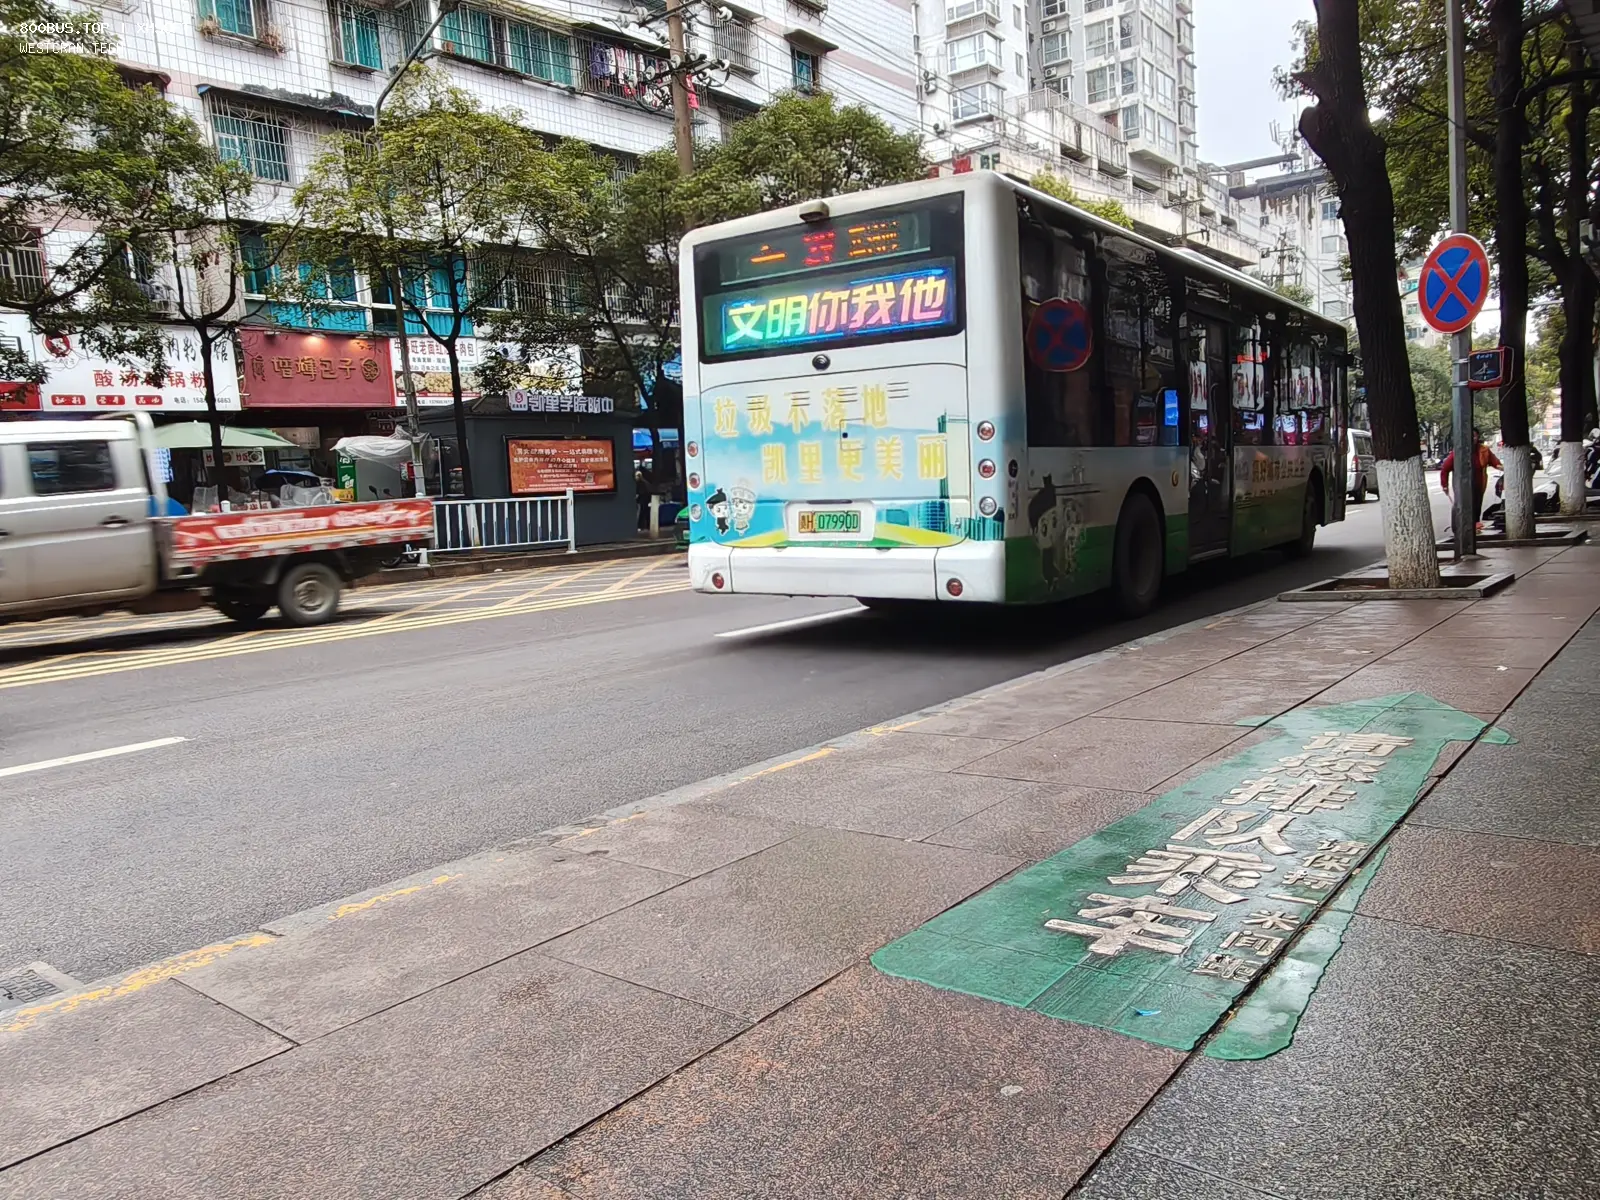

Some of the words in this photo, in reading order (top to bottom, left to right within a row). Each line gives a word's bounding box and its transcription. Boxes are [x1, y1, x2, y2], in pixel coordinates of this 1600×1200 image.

[726, 276, 947, 345] 文明你我他
[93, 369, 206, 389] 酸汤锅粉
[528, 394, 615, 414] 凯里学院附中
[713, 384, 889, 439] 垃圾不落地
[760, 434, 948, 486] 凯里更美丽
[1044, 731, 1415, 957] 请您排队乘车
[1193, 838, 1370, 983] 请保持一米间距
